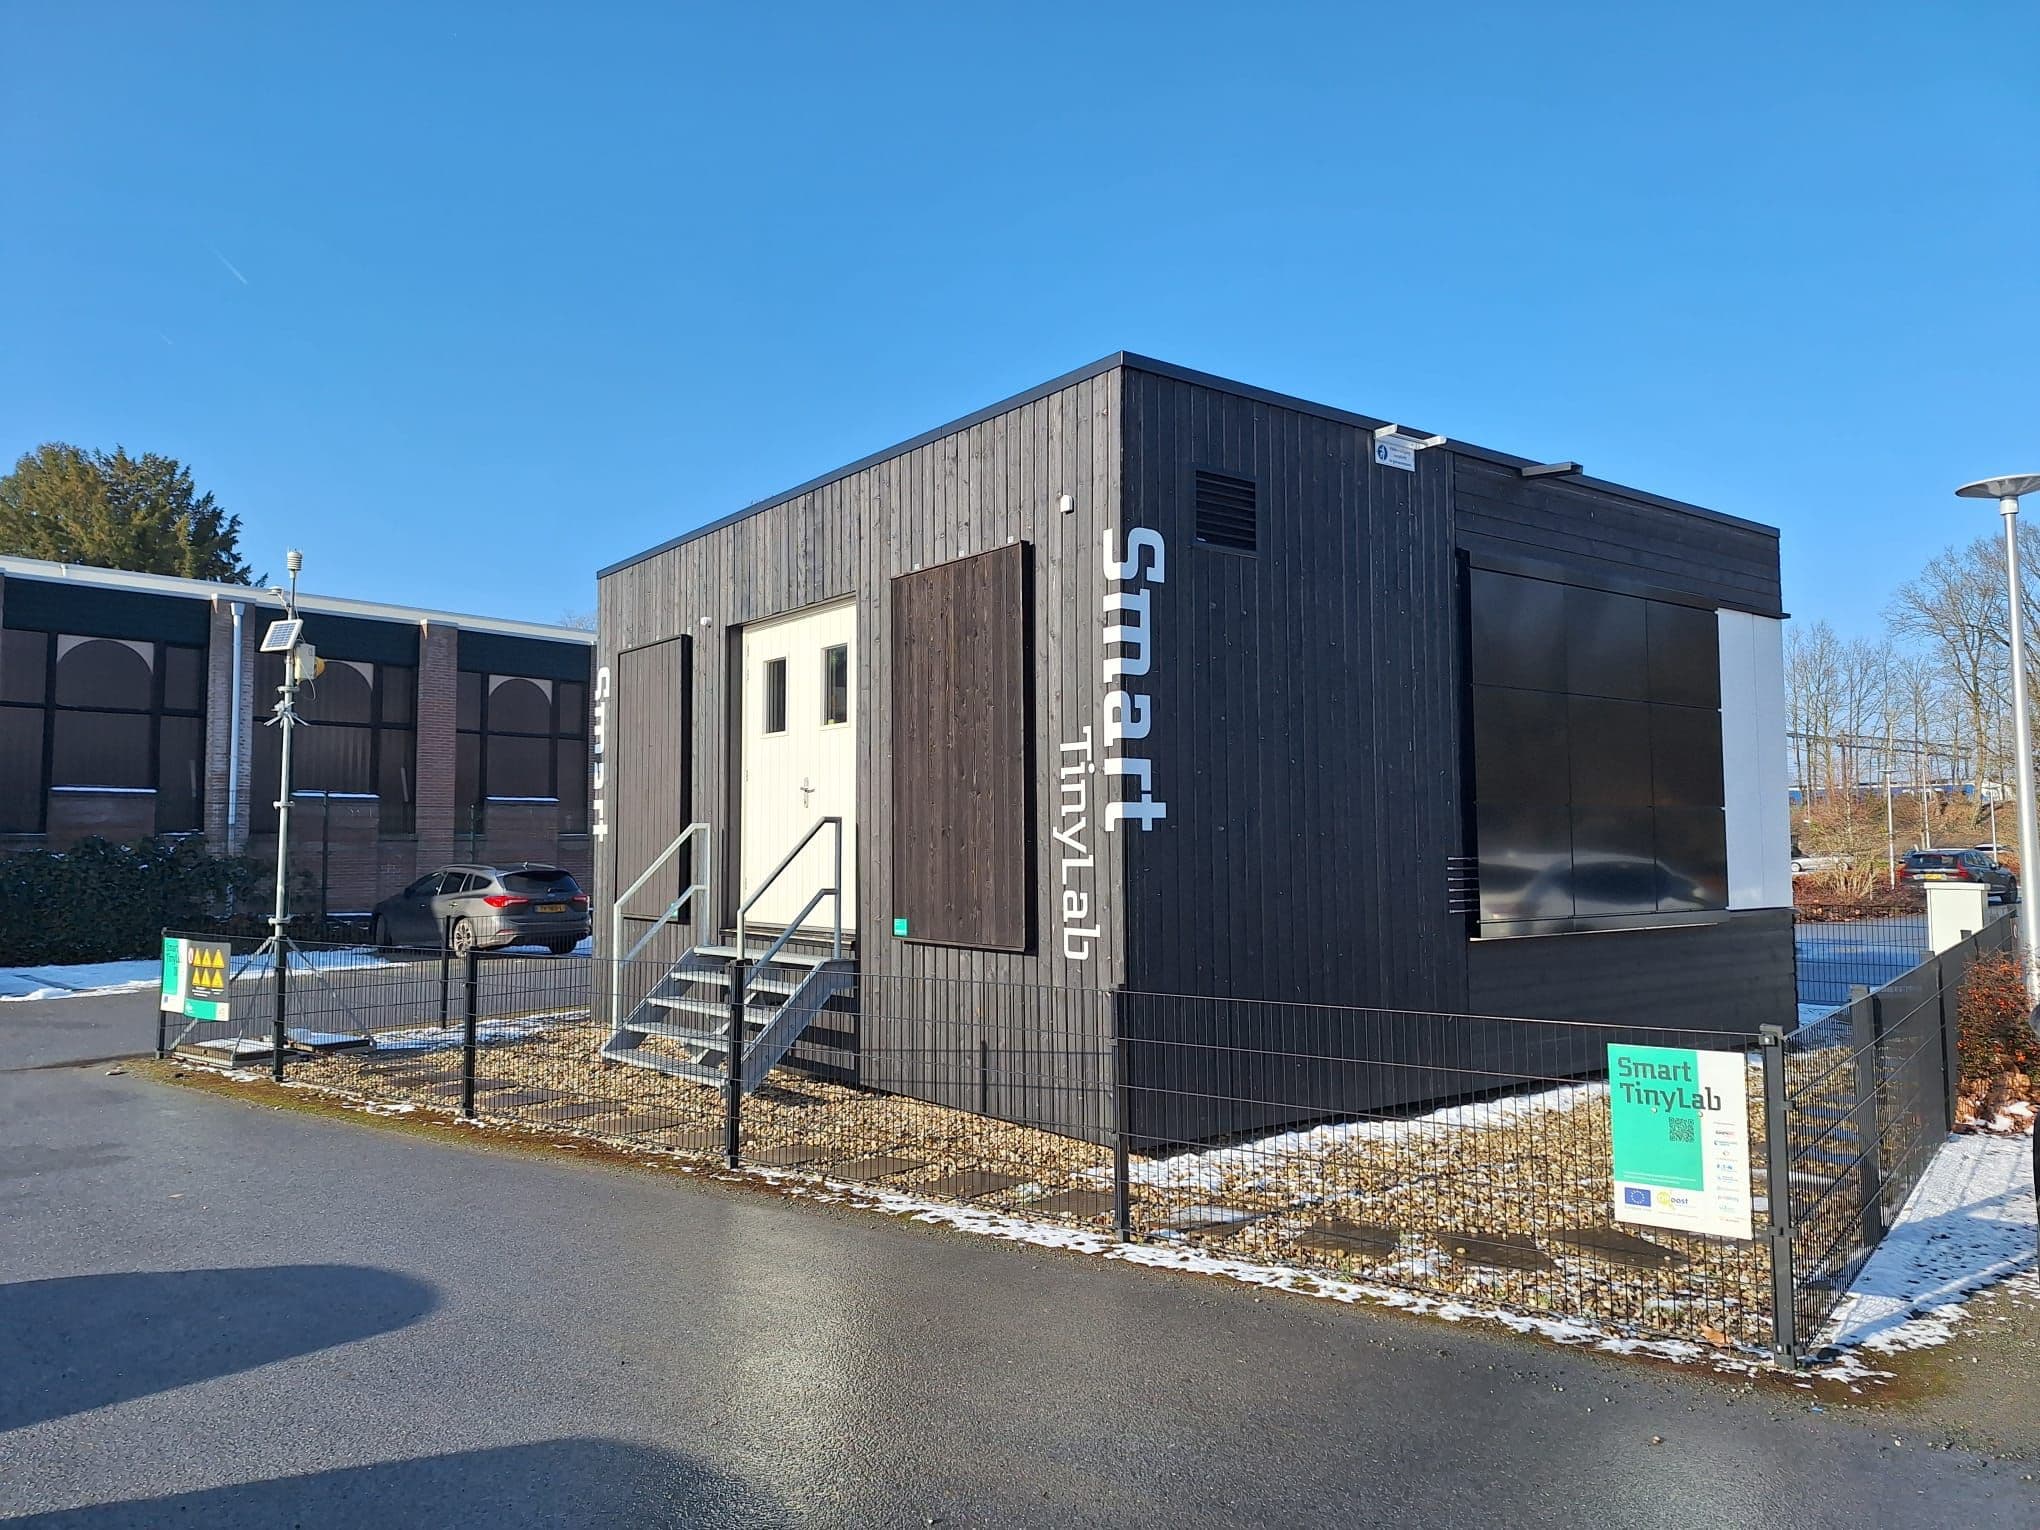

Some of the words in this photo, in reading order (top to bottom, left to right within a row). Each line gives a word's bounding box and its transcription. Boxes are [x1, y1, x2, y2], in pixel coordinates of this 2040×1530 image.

[1103, 527, 1166, 832] Smart
[1053, 725, 1101, 960] TinyLab
[1617, 1056, 1692, 1082] Smart
[1620, 1082, 1721, 1113] TinyLab
